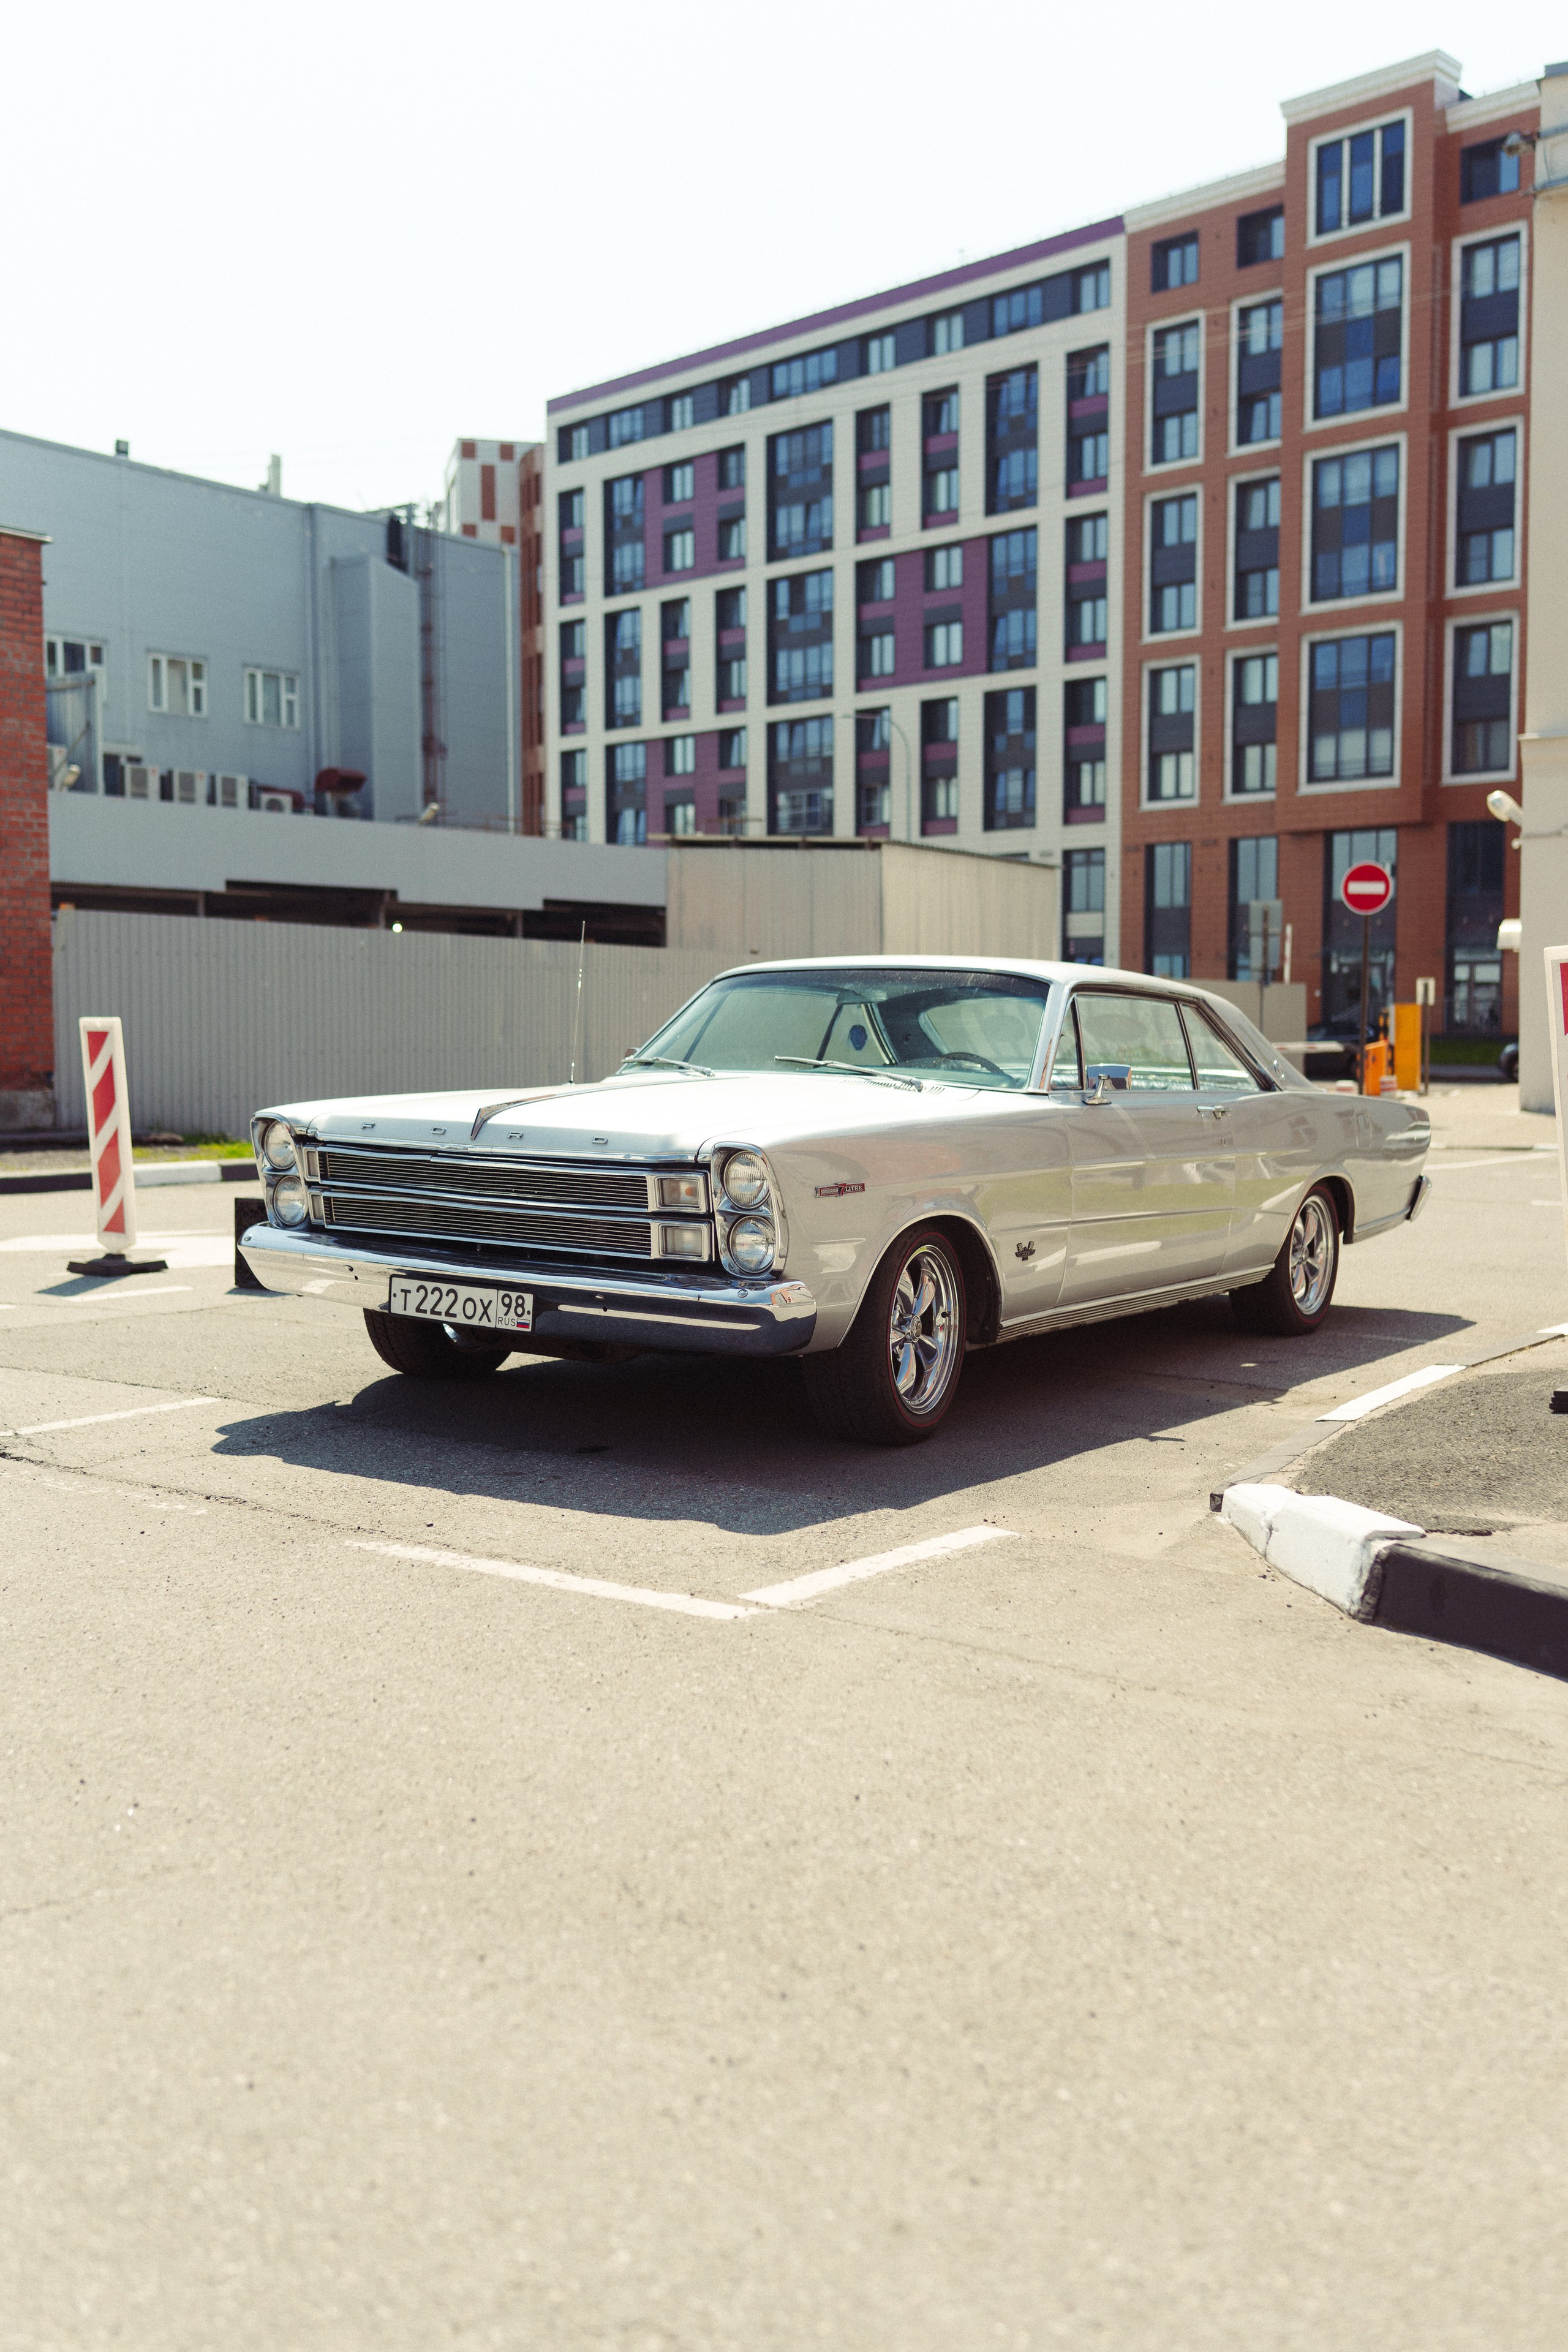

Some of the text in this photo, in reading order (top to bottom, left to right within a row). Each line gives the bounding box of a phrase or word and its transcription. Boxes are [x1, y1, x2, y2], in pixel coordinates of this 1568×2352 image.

[361, 1122, 609, 1144] FORD
[839, 1183, 846, 1196] 7
[501, 1293, 526, 1317] 98
[498, 1317, 516, 1327] RUS
